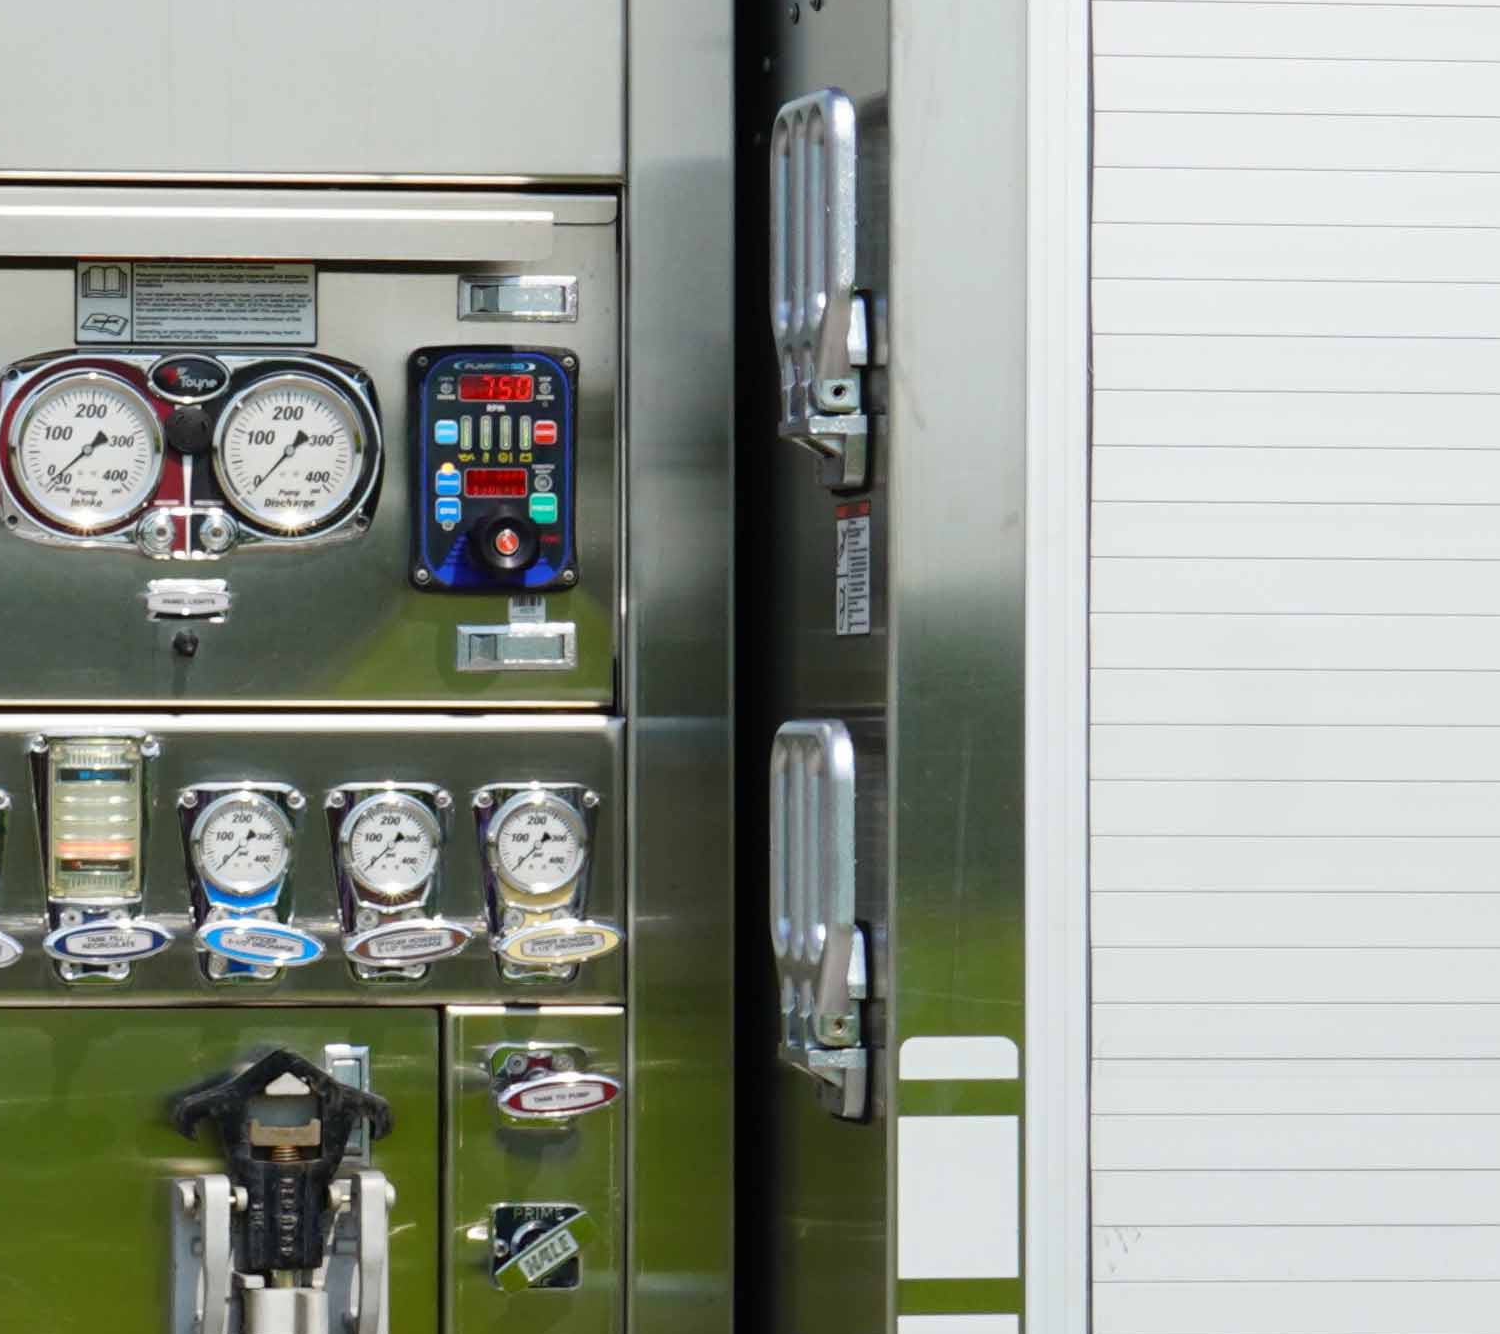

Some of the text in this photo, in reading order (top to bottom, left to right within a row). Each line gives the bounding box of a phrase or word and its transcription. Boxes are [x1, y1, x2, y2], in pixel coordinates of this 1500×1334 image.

[483, 376, 532, 400] 750
[75, 403, 107, 419] 200
[272, 405, 304, 421] 200
[45, 426, 73, 441] 100
[248, 430, 275, 445] 100
[109, 435, 134, 449] 300
[309, 434, 335, 447] 300
[47, 464, 56, 476] 0
[103, 469, 128, 482] 400
[305, 471, 330, 483] 400
[264, 498, 316, 508] Discharge
[232, 814, 252, 824] 200
[380, 816, 400, 825] 200
[528, 816, 547, 825] 200
[216, 831, 234, 841] 100
[365, 832, 382, 842] 100
[512, 833, 529, 842] 100
[254, 855, 270, 863] 400
[402, 856, 418, 864] 400
[549, 856, 564, 864] 400
[512, 1207, 565, 1220] PRIME
[523, 1232, 573, 1277] HALE
